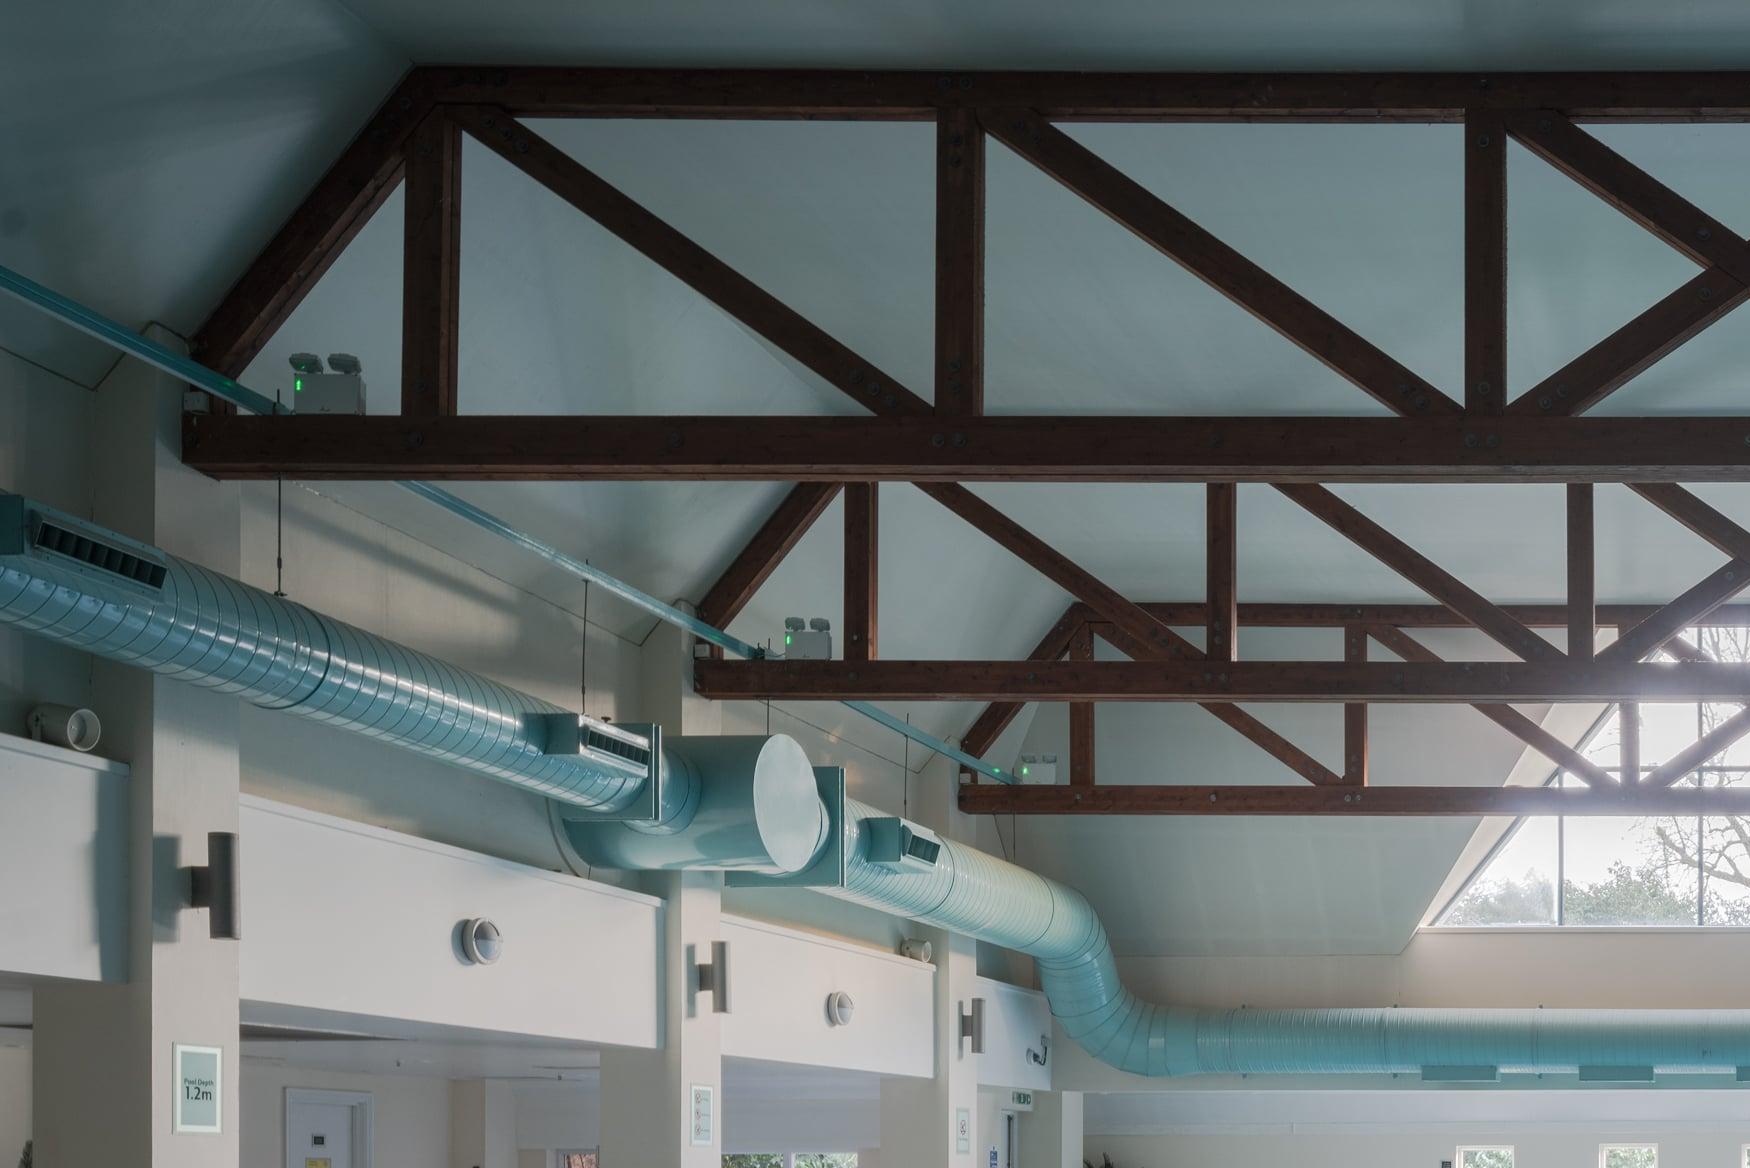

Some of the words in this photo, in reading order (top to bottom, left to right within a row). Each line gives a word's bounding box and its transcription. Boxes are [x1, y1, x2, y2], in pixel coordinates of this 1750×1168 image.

[184, 1078, 197, 1086] Pool
[197, 1079, 214, 1087] Depth
[185, 1086, 212, 1100] 1.2m
